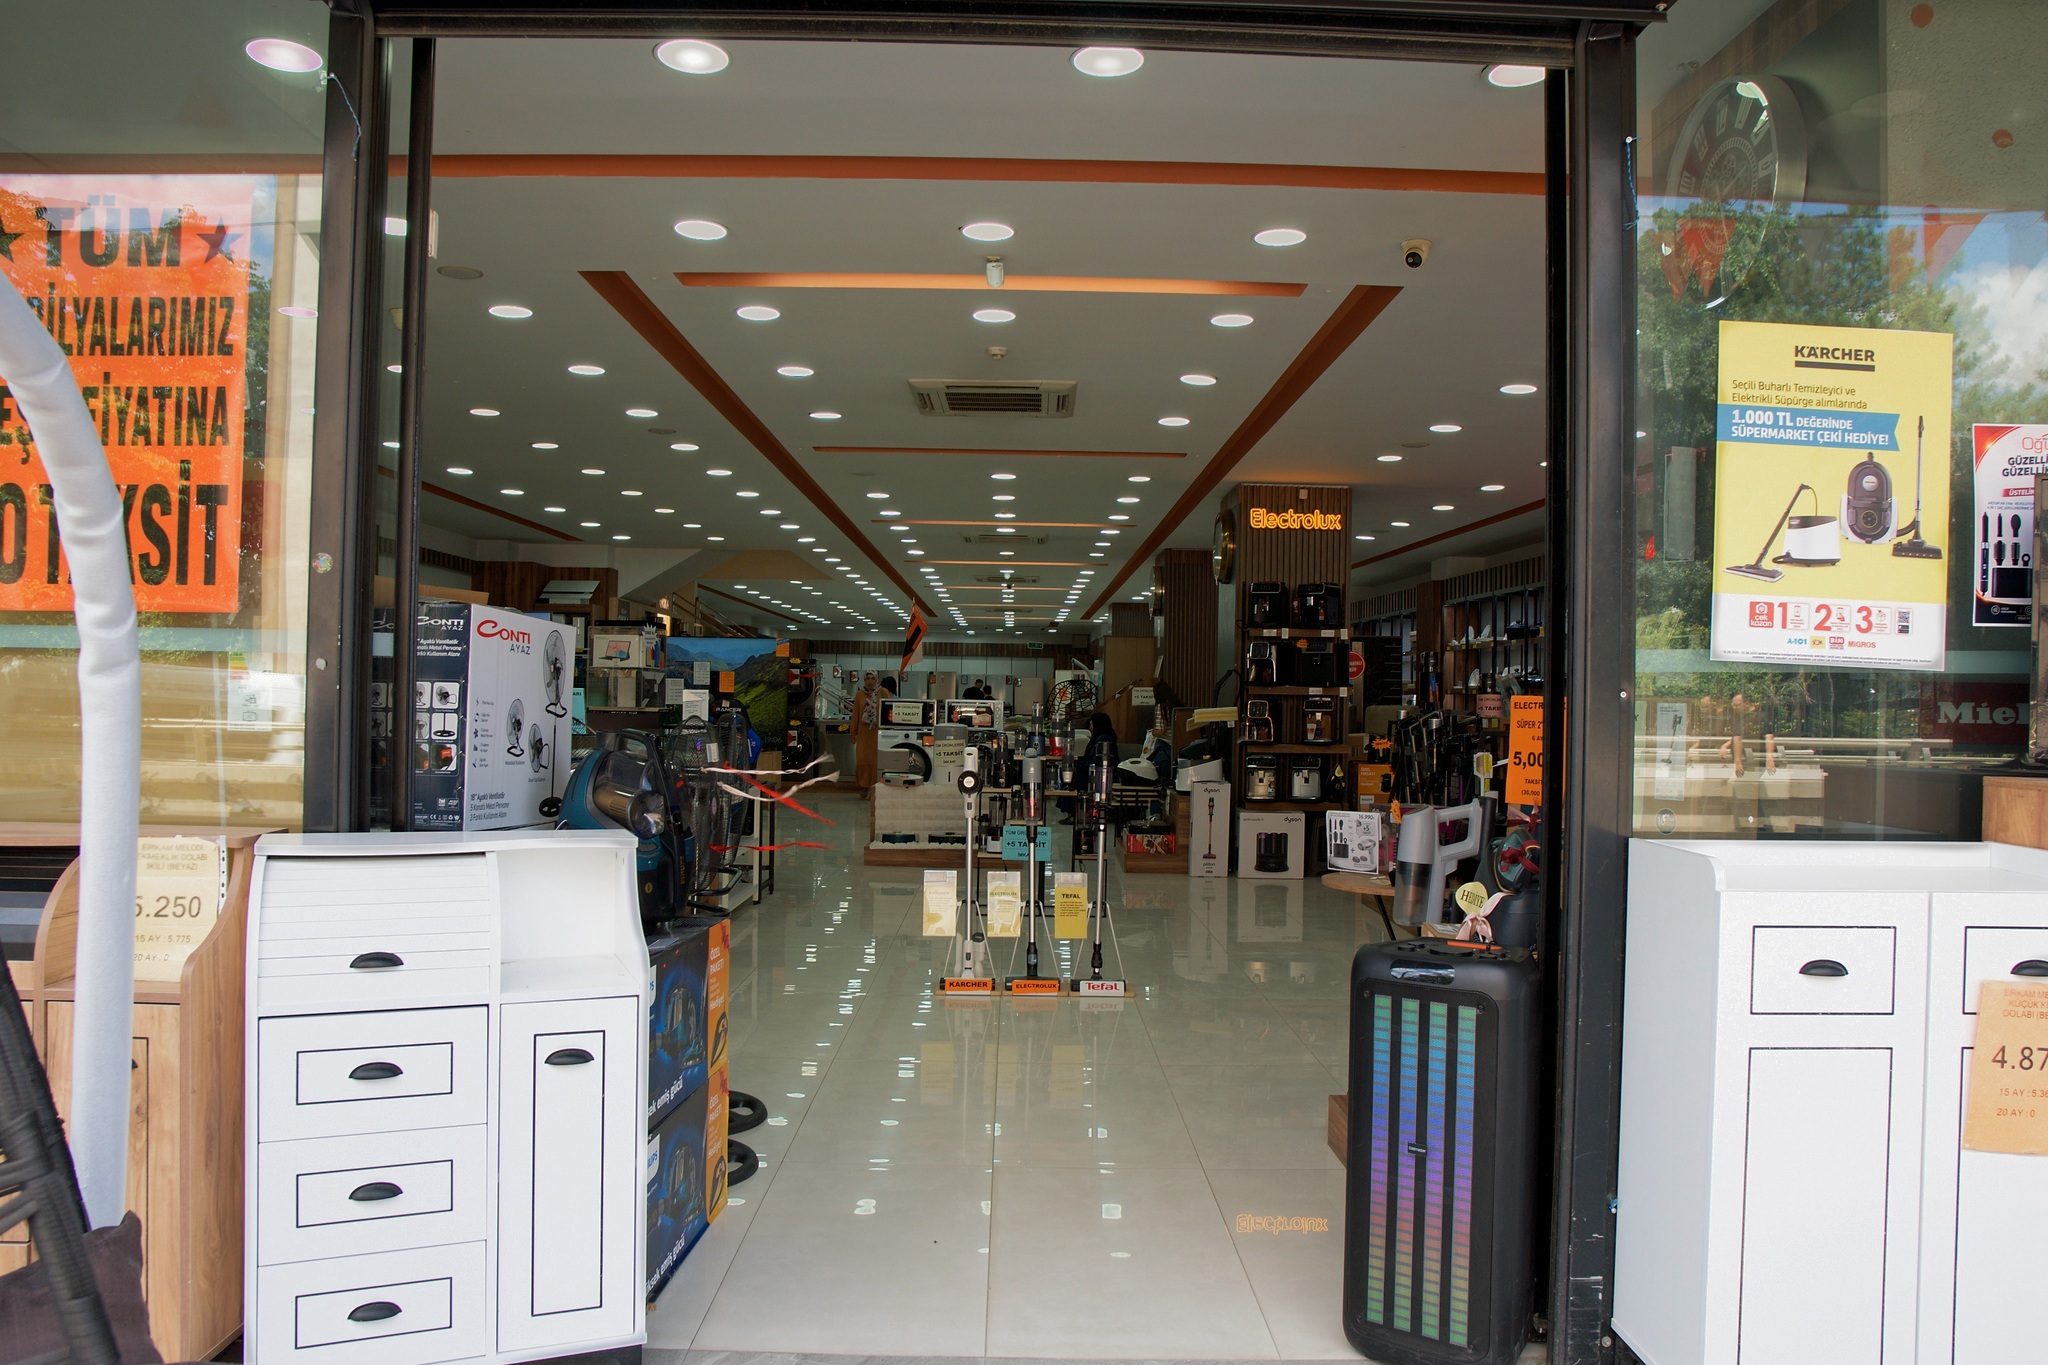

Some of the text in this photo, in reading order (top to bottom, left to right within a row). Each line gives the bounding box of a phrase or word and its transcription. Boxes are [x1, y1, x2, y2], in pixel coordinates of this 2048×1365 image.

[39, 195, 182, 267] TÜM
[1794, 345, 1875, 362] KÄRCHER
[1732, 380, 1856, 397] Seçili Buharlı Temizleyici ve
[1732, 392, 1867, 410] Elektrikli Süpürge alımlarında
[1732, 409, 1853, 430] 1.000 TL DEĞERİNDE
[1731, 425, 1889, 446] SÜPERMARKET ÇEKİ HEDİYE!
[39, 459, 229, 585] TKSİT
[1250, 507, 1342, 530] Electrolux
[1777, 602, 1873, 633] 1 2 3
[510, 644, 531, 656] AYAZ
[1514, 701, 1543, 710] ELECTR
[1937, 701, 2030, 725] Miel
[1517, 718, 1536, 729] SÜPER
[148, 934, 160, 943] AY
[1087, 982, 1120, 991] Tefal
[2036, 1011, 2048, 1020] (BE
[2013, 1088, 2025, 1097] AY
[2010, 1108, 2023, 1117] AY
